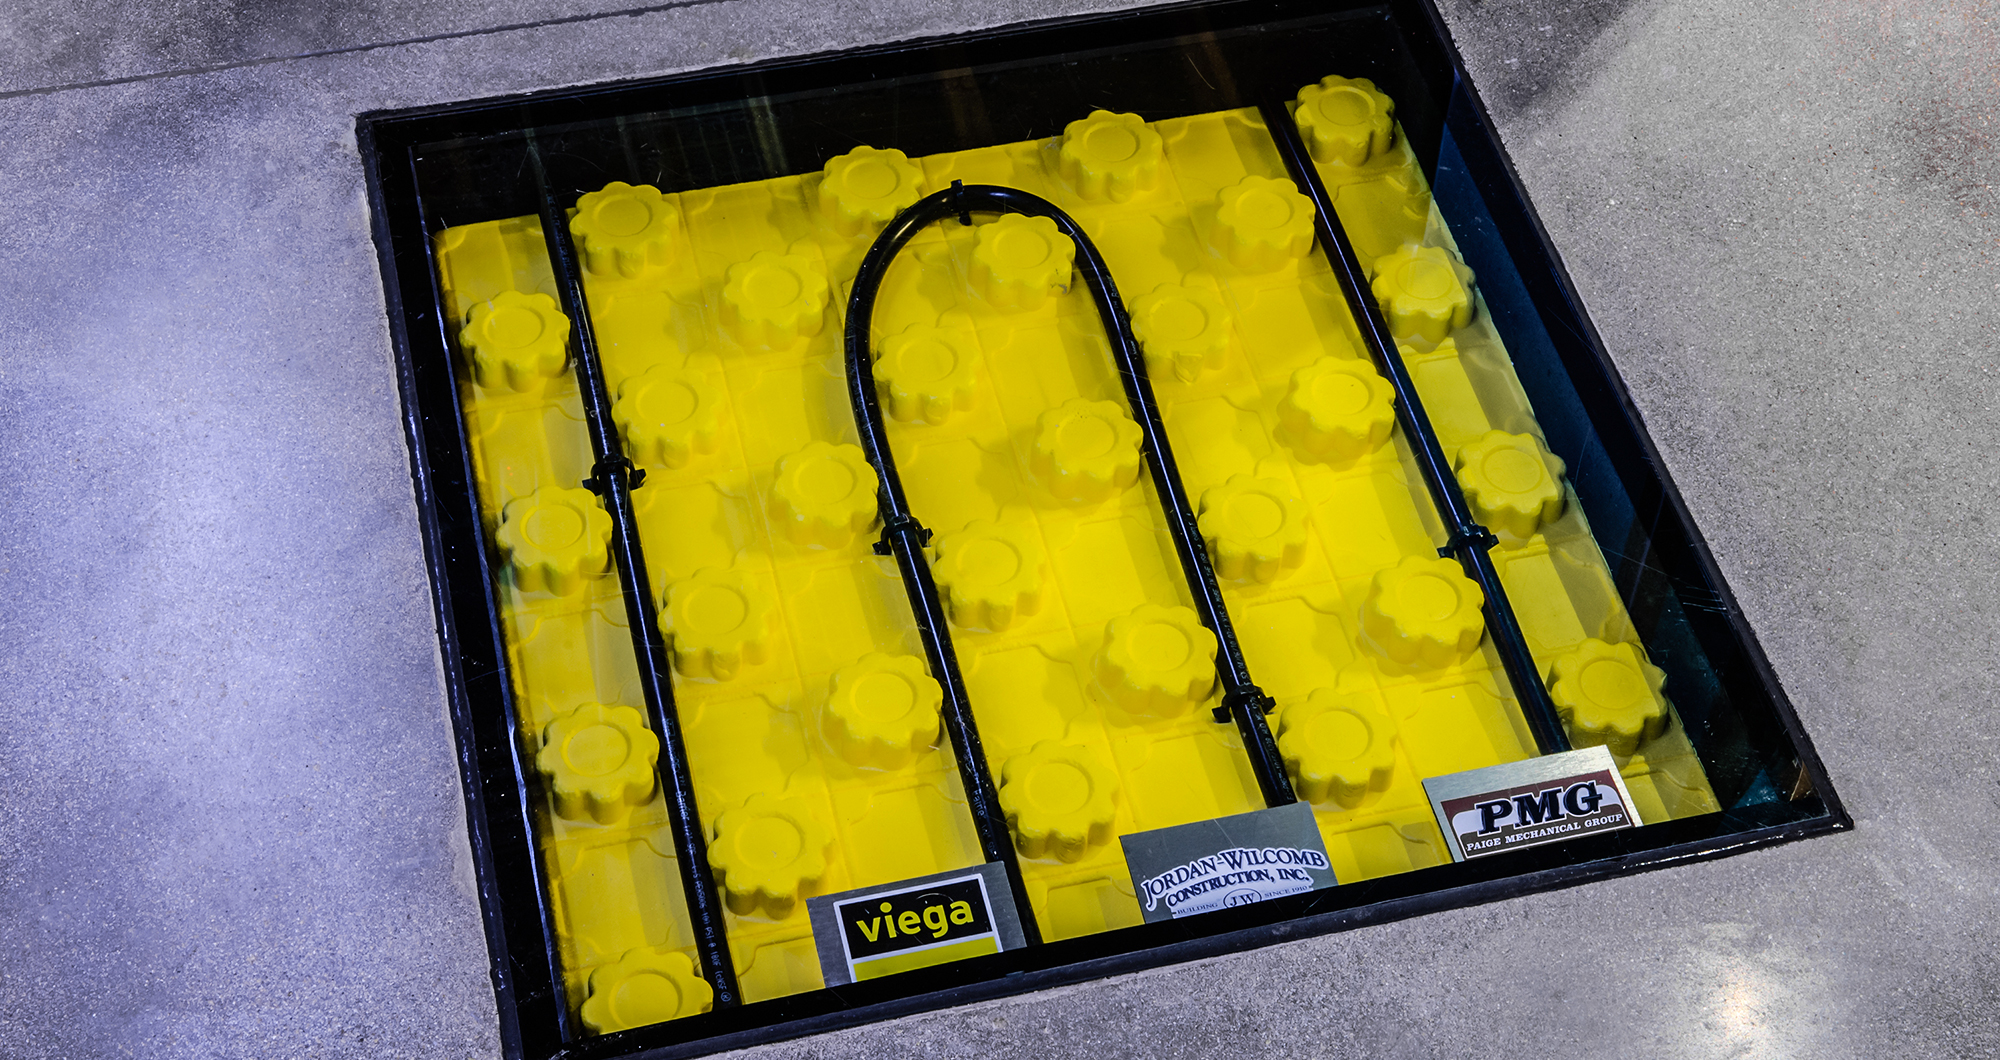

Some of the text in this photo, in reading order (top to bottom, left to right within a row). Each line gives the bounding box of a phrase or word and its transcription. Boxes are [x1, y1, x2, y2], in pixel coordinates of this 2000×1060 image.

[1475, 781, 1603, 835] PMG
[1466, 813, 1623, 852] PAIGE MECHANICAL GROUP
[1143, 850, 1325, 907] JORDAN-WILCOMB
[1167, 867, 1310, 906] CONSTRUCTION, INC.
[856, 900, 974, 943] viega
[1177, 902, 1219, 915] BUILDING
[1264, 889, 1290, 898] SINCE
